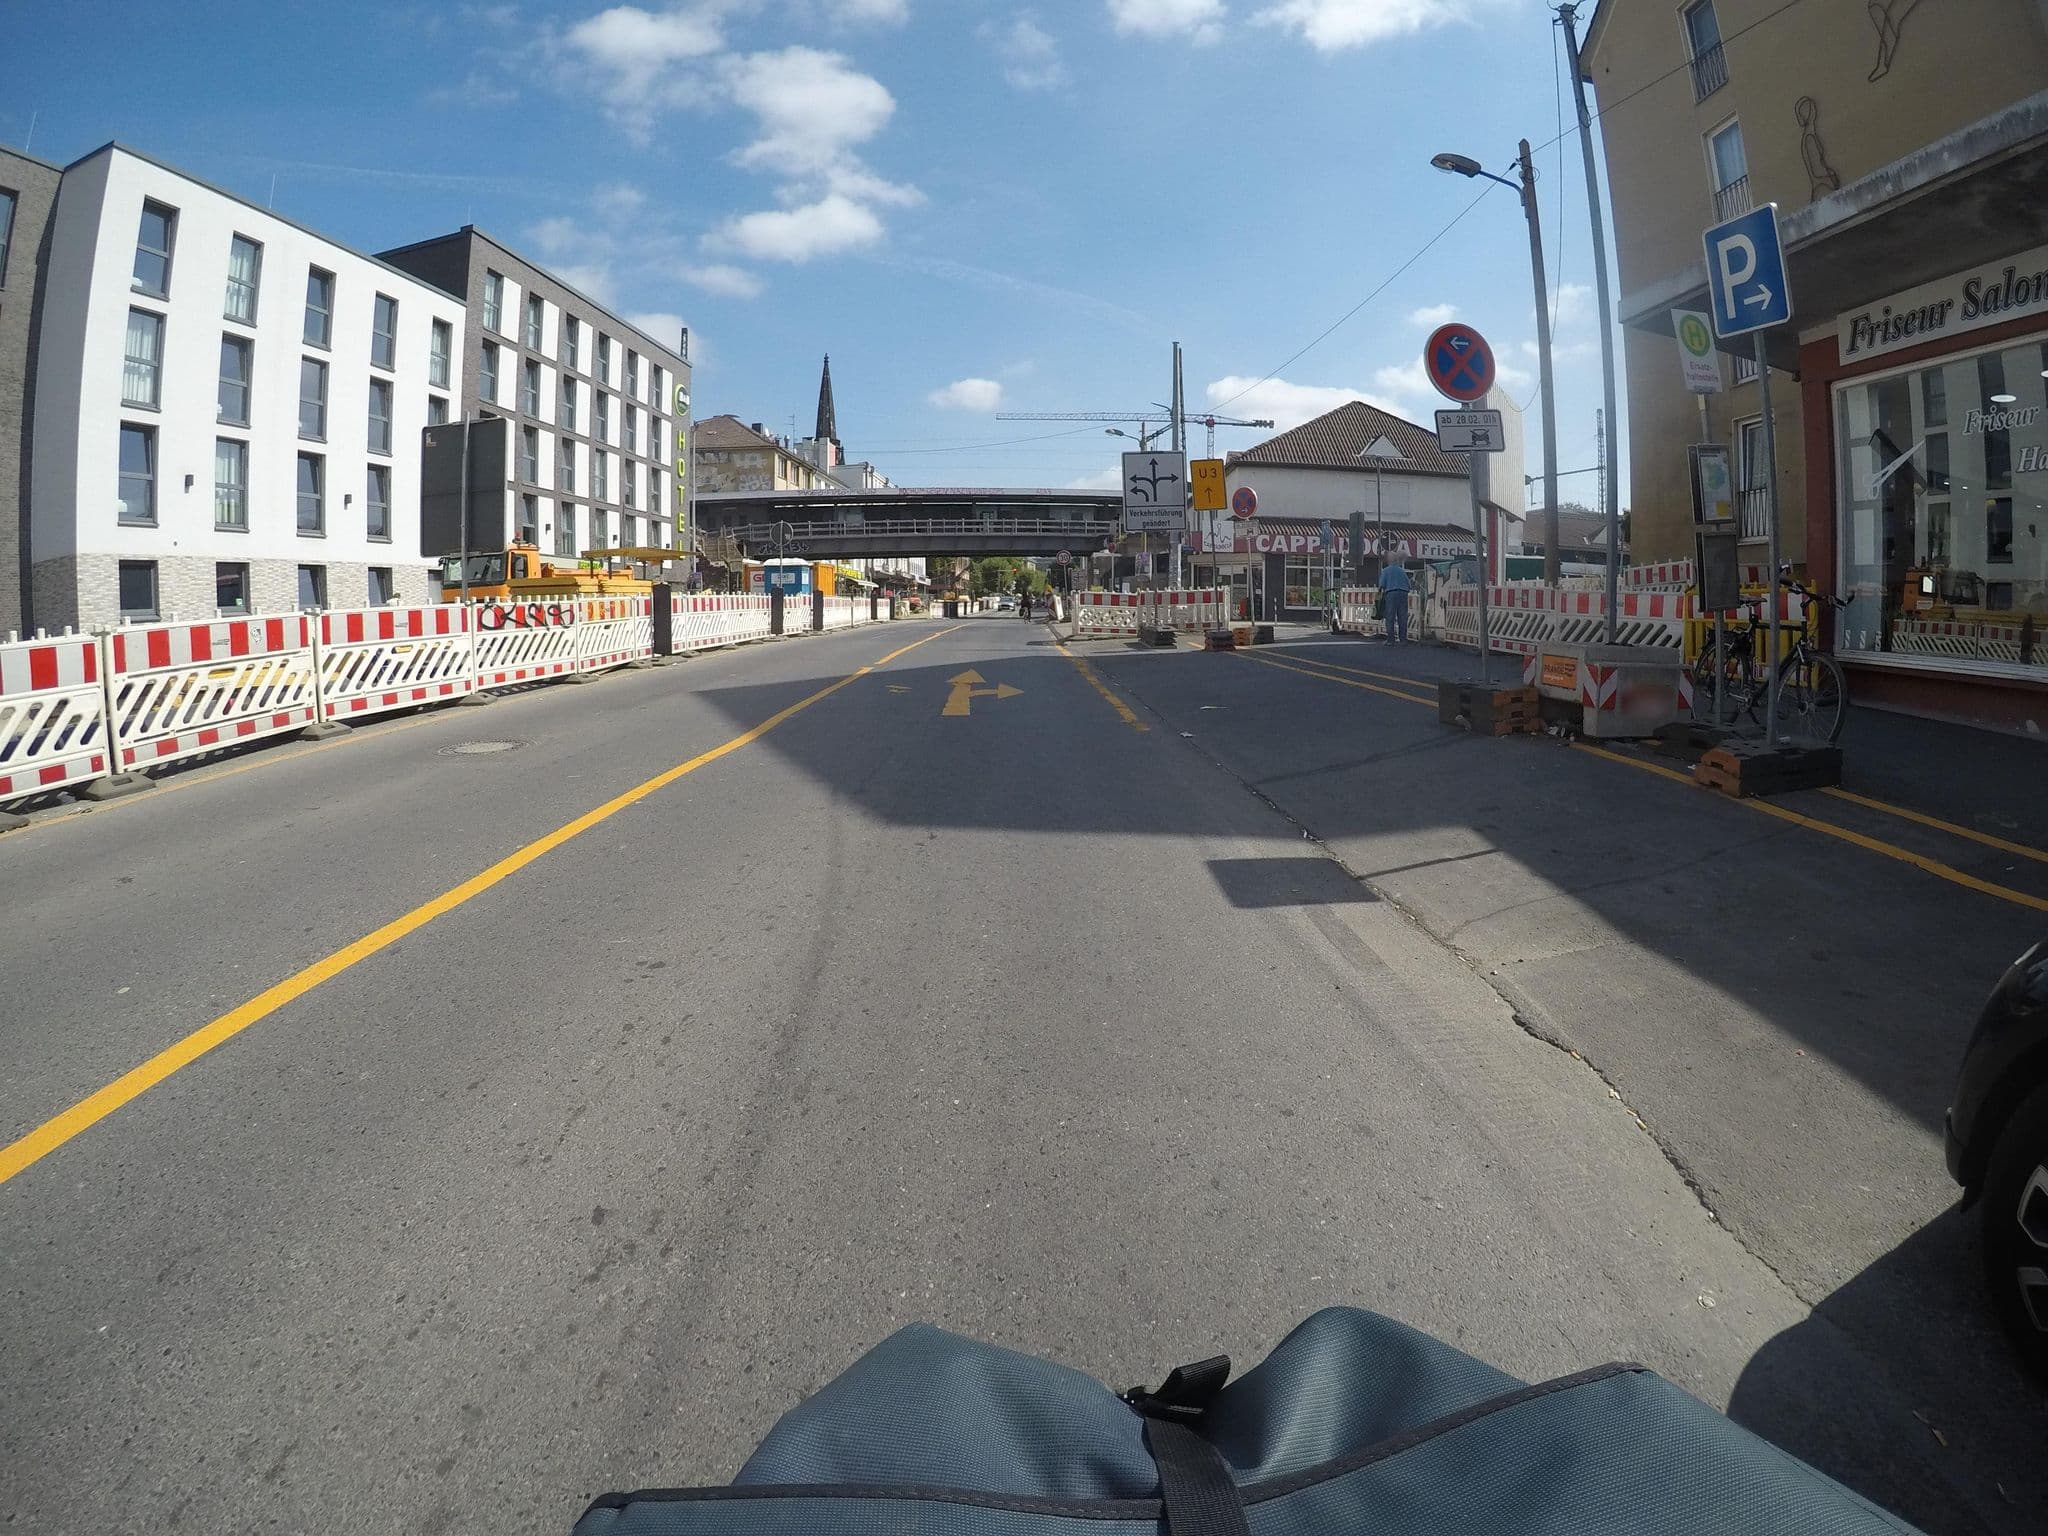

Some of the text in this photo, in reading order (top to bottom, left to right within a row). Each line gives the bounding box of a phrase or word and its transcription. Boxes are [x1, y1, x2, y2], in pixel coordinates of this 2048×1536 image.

[1717, 233, 1757, 319] P
[1846, 265, 2048, 356] Friseur Salon
[1684, 323, 1707, 349] H
[1441, 415, 1452, 424] ab
[1962, 405, 2041, 436] Friseur
[1198, 468, 1217, 478] U 3
[677, 429, 686, 561] HOTEL
[1129, 509, 1183, 518] Verkehrsführung
[1142, 520, 1171, 528] geändert
[1421, 543, 1472, 556] Frische
